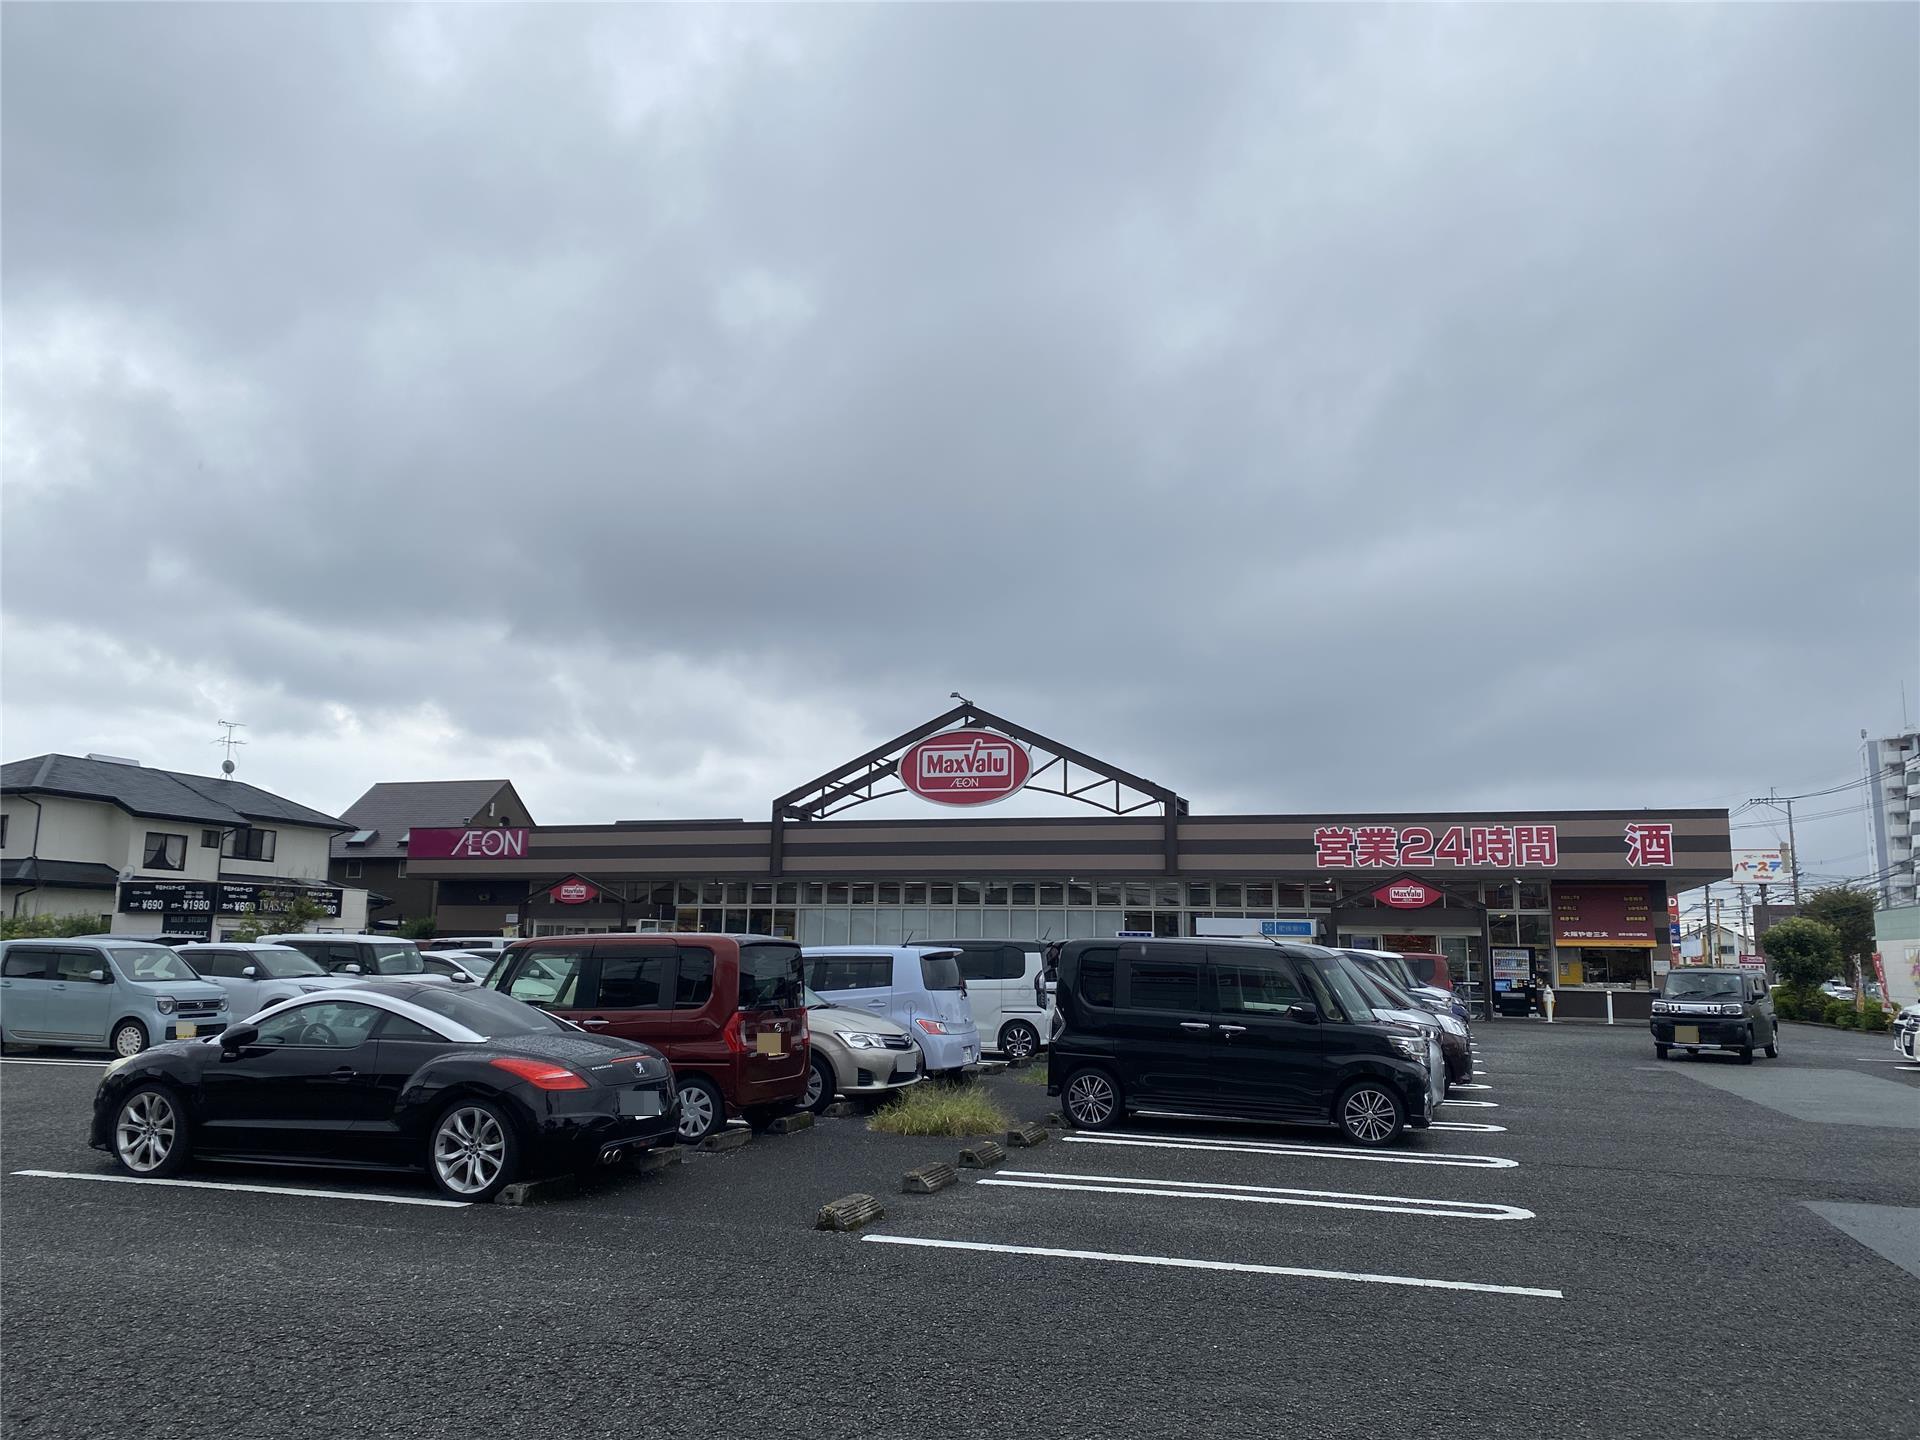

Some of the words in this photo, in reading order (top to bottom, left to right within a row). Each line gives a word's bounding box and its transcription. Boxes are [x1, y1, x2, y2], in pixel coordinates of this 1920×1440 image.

[926, 740, 1005, 774] MaxValu
[1314, 825, 1558, 867] 営業24時間
[1624, 823, 1674, 867] 酒
[142, 899, 163, 910] ¥690
[183, 899, 210, 910] ¥1980
[1393, 886, 1422, 898] MaxValu
